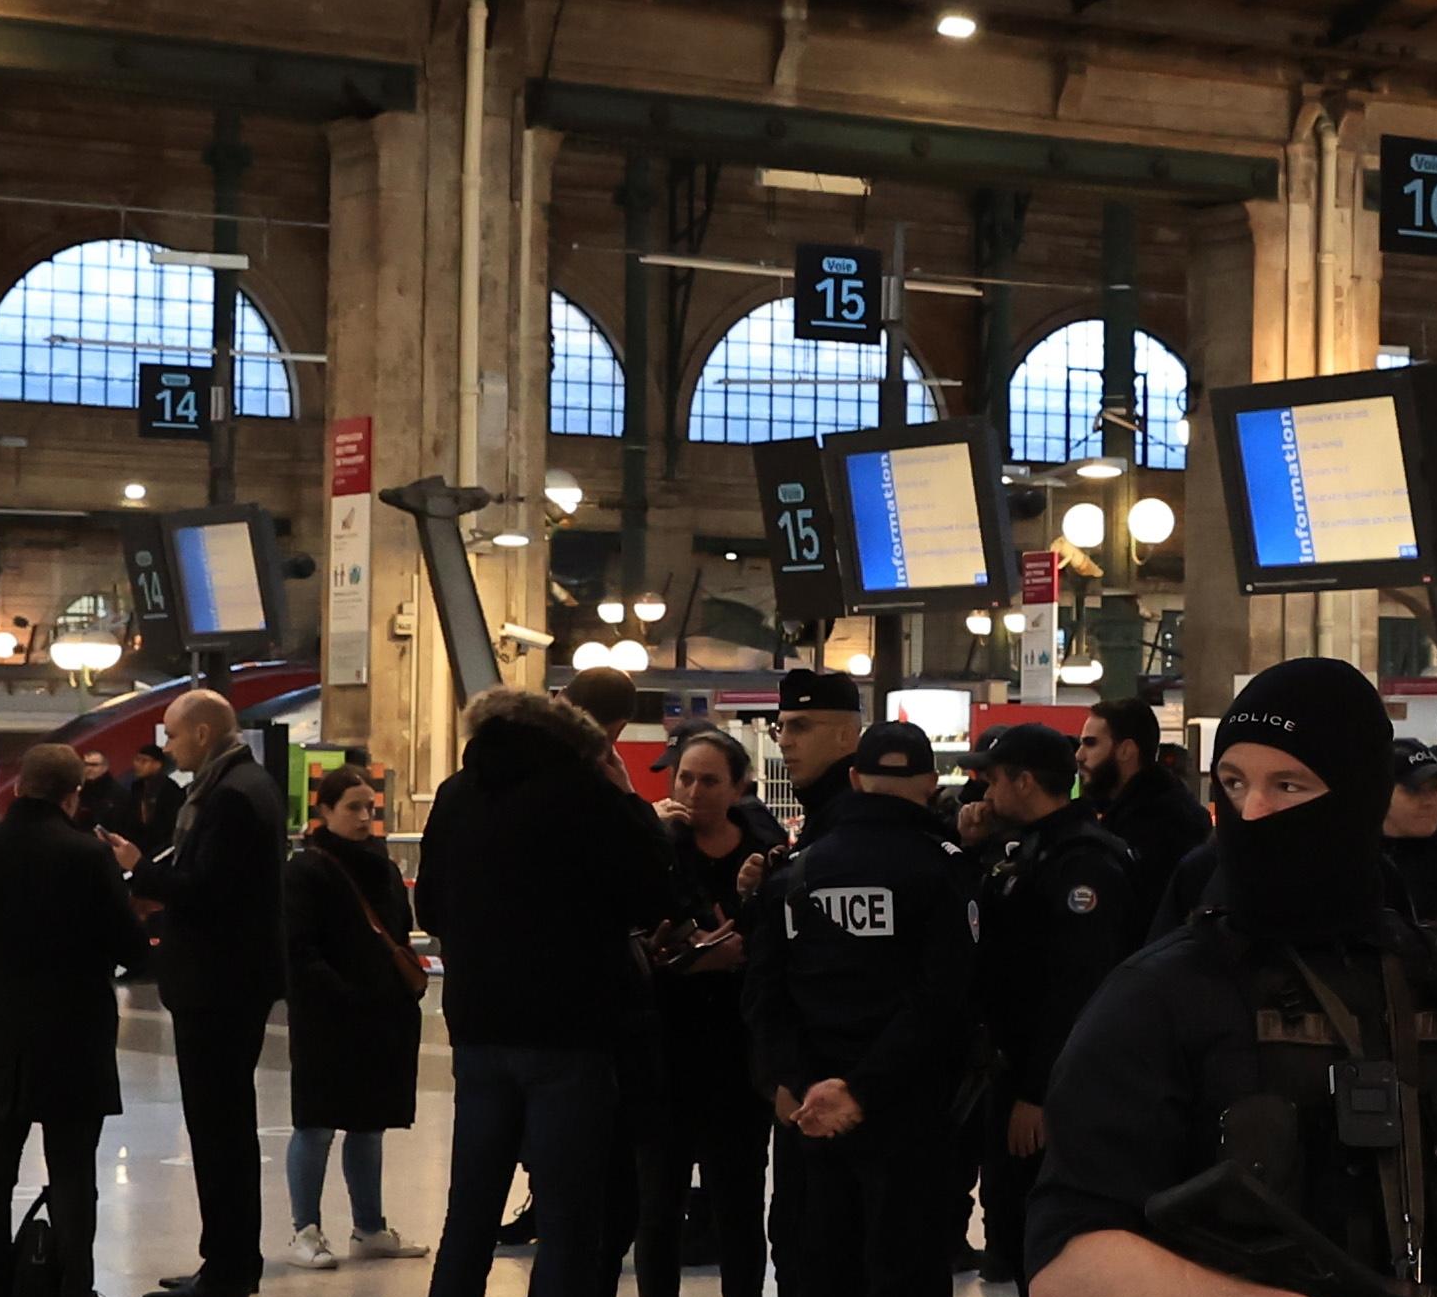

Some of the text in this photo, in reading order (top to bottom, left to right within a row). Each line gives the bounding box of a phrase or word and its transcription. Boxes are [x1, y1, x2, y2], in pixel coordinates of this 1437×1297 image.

[827, 259, 853, 273] Voie
[815, 278, 866, 321] 15
[156, 389, 197, 422] 14
[1279, 410, 1314, 564] information
[777, 508, 820, 562] 15
[880, 454, 907, 588] information
[138, 571, 164, 610] 14
[1229, 712, 1297, 732] POLICE
